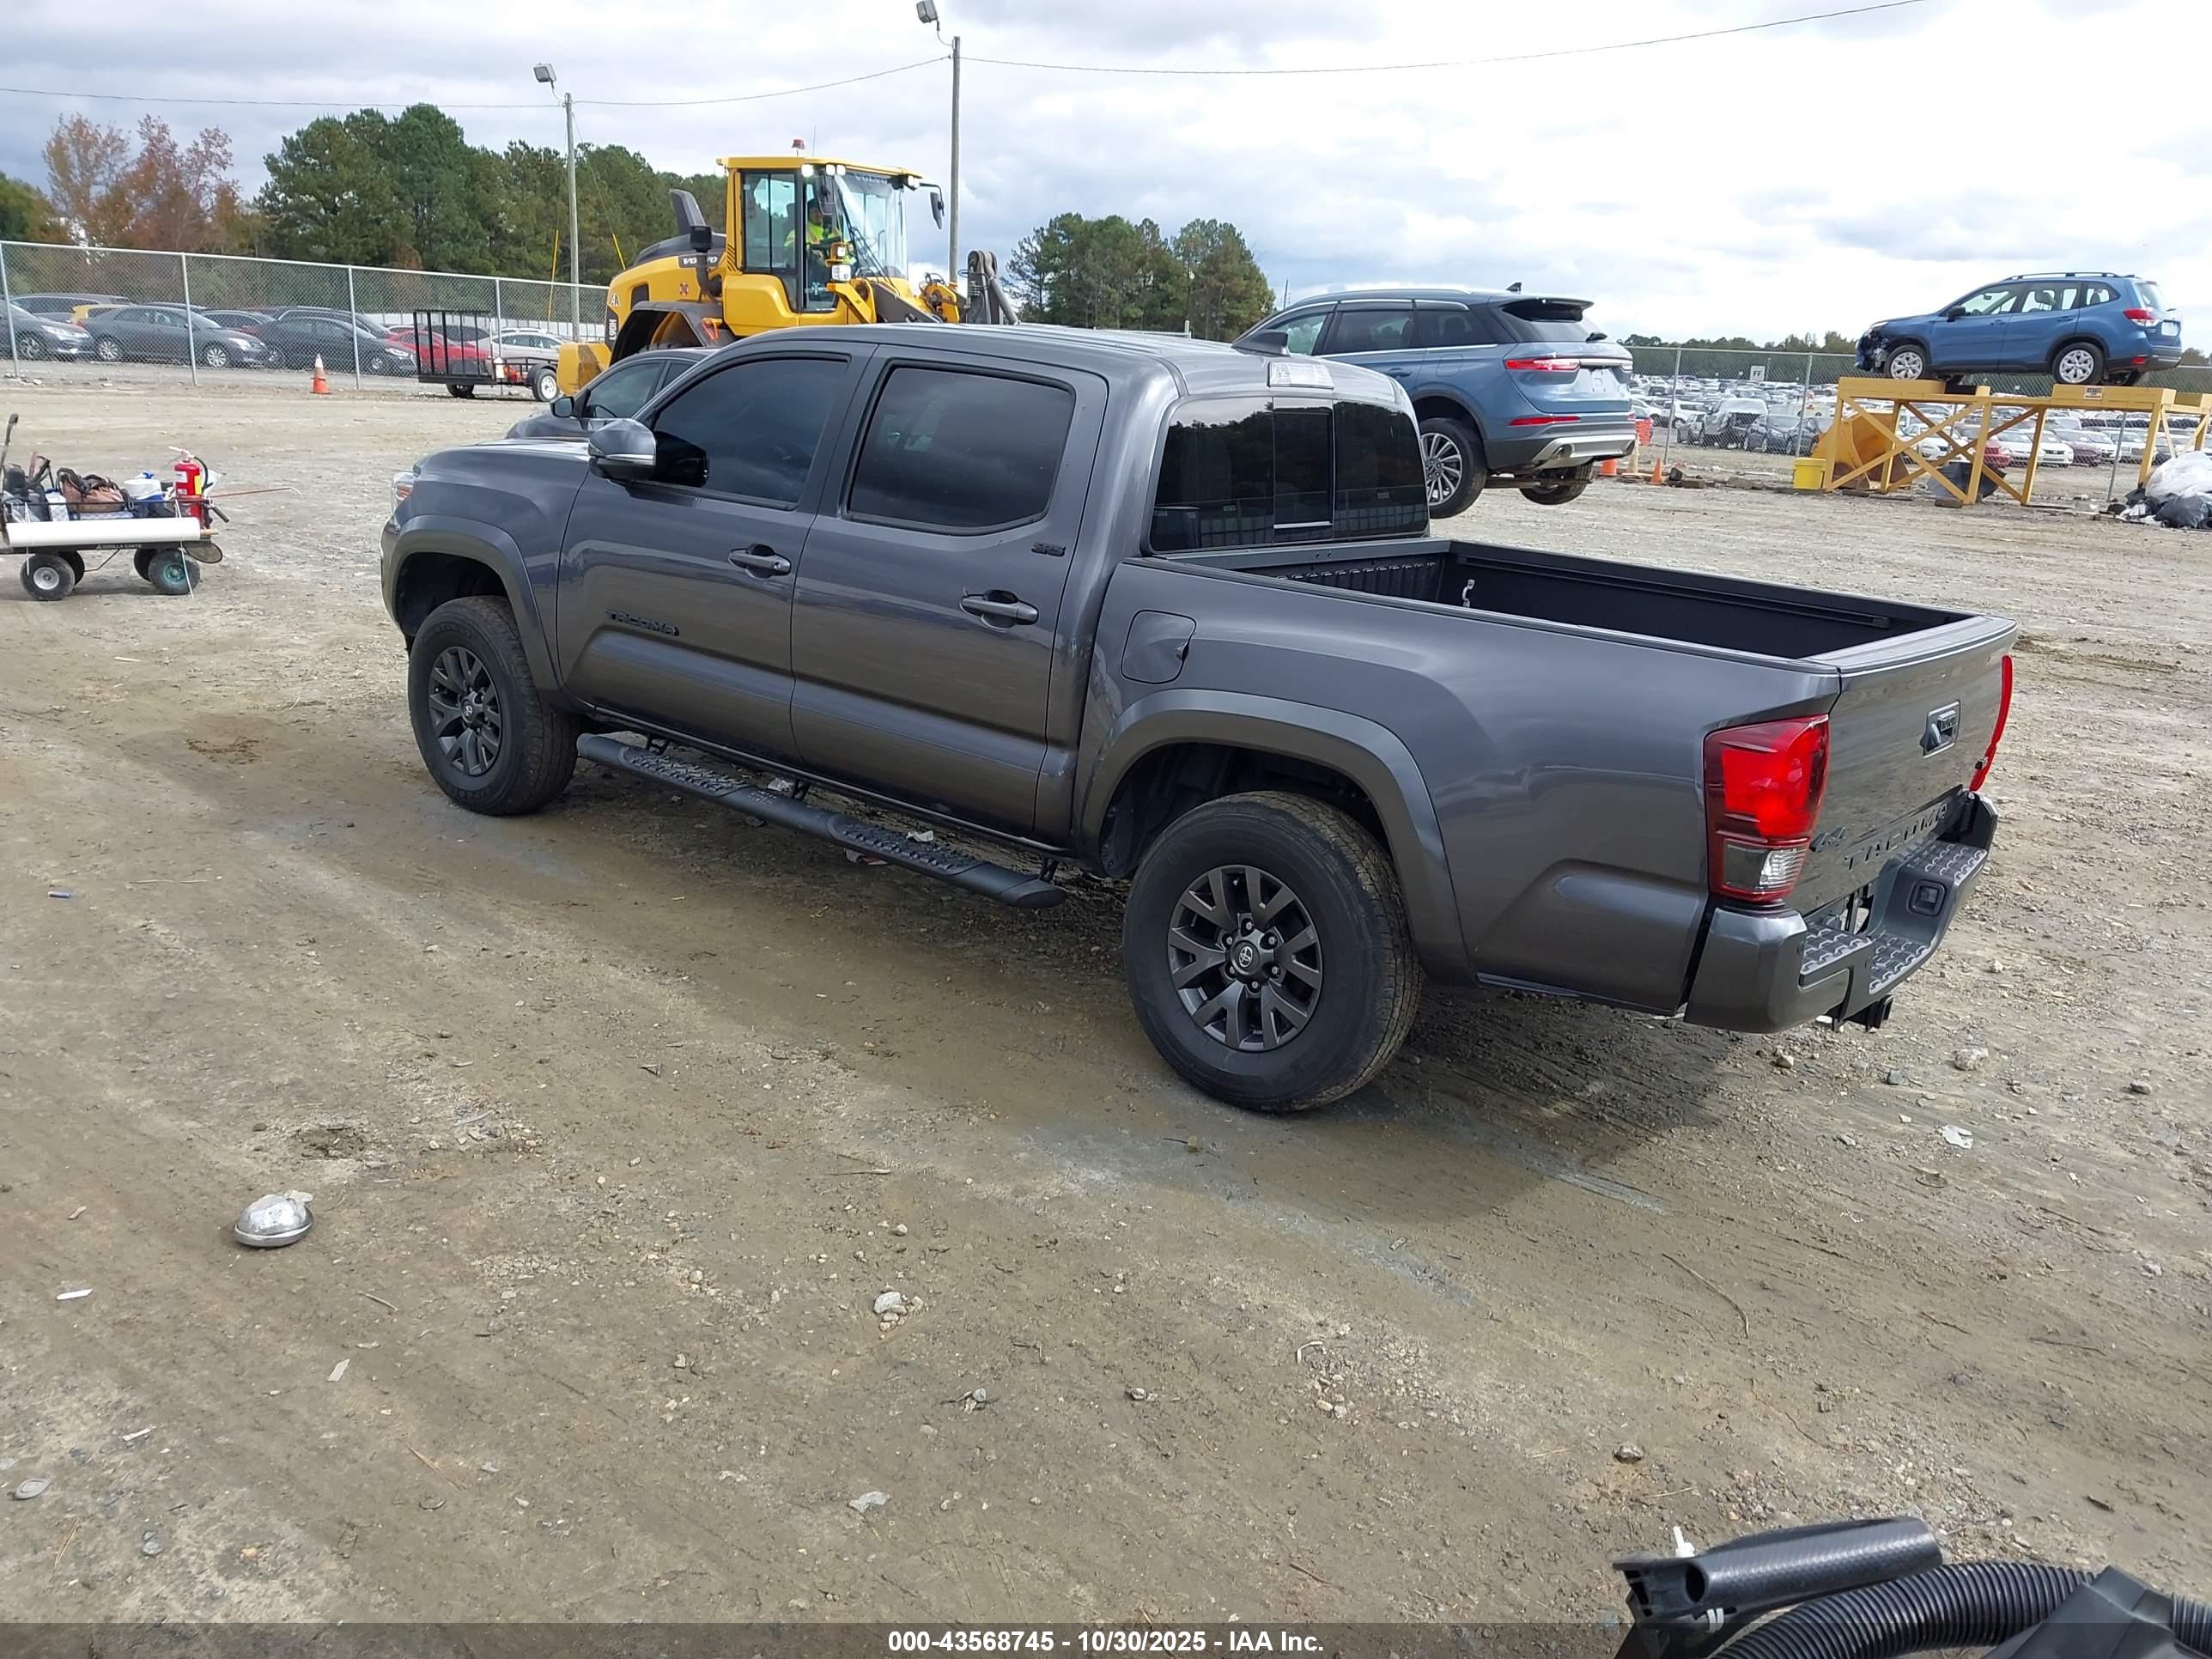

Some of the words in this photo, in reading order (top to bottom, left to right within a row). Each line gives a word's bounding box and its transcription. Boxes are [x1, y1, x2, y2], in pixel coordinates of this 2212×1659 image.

[683, 256, 718, 264] VOVO
[605, 608, 679, 636] TACOMA
[1844, 804, 1948, 872] TACOMA
